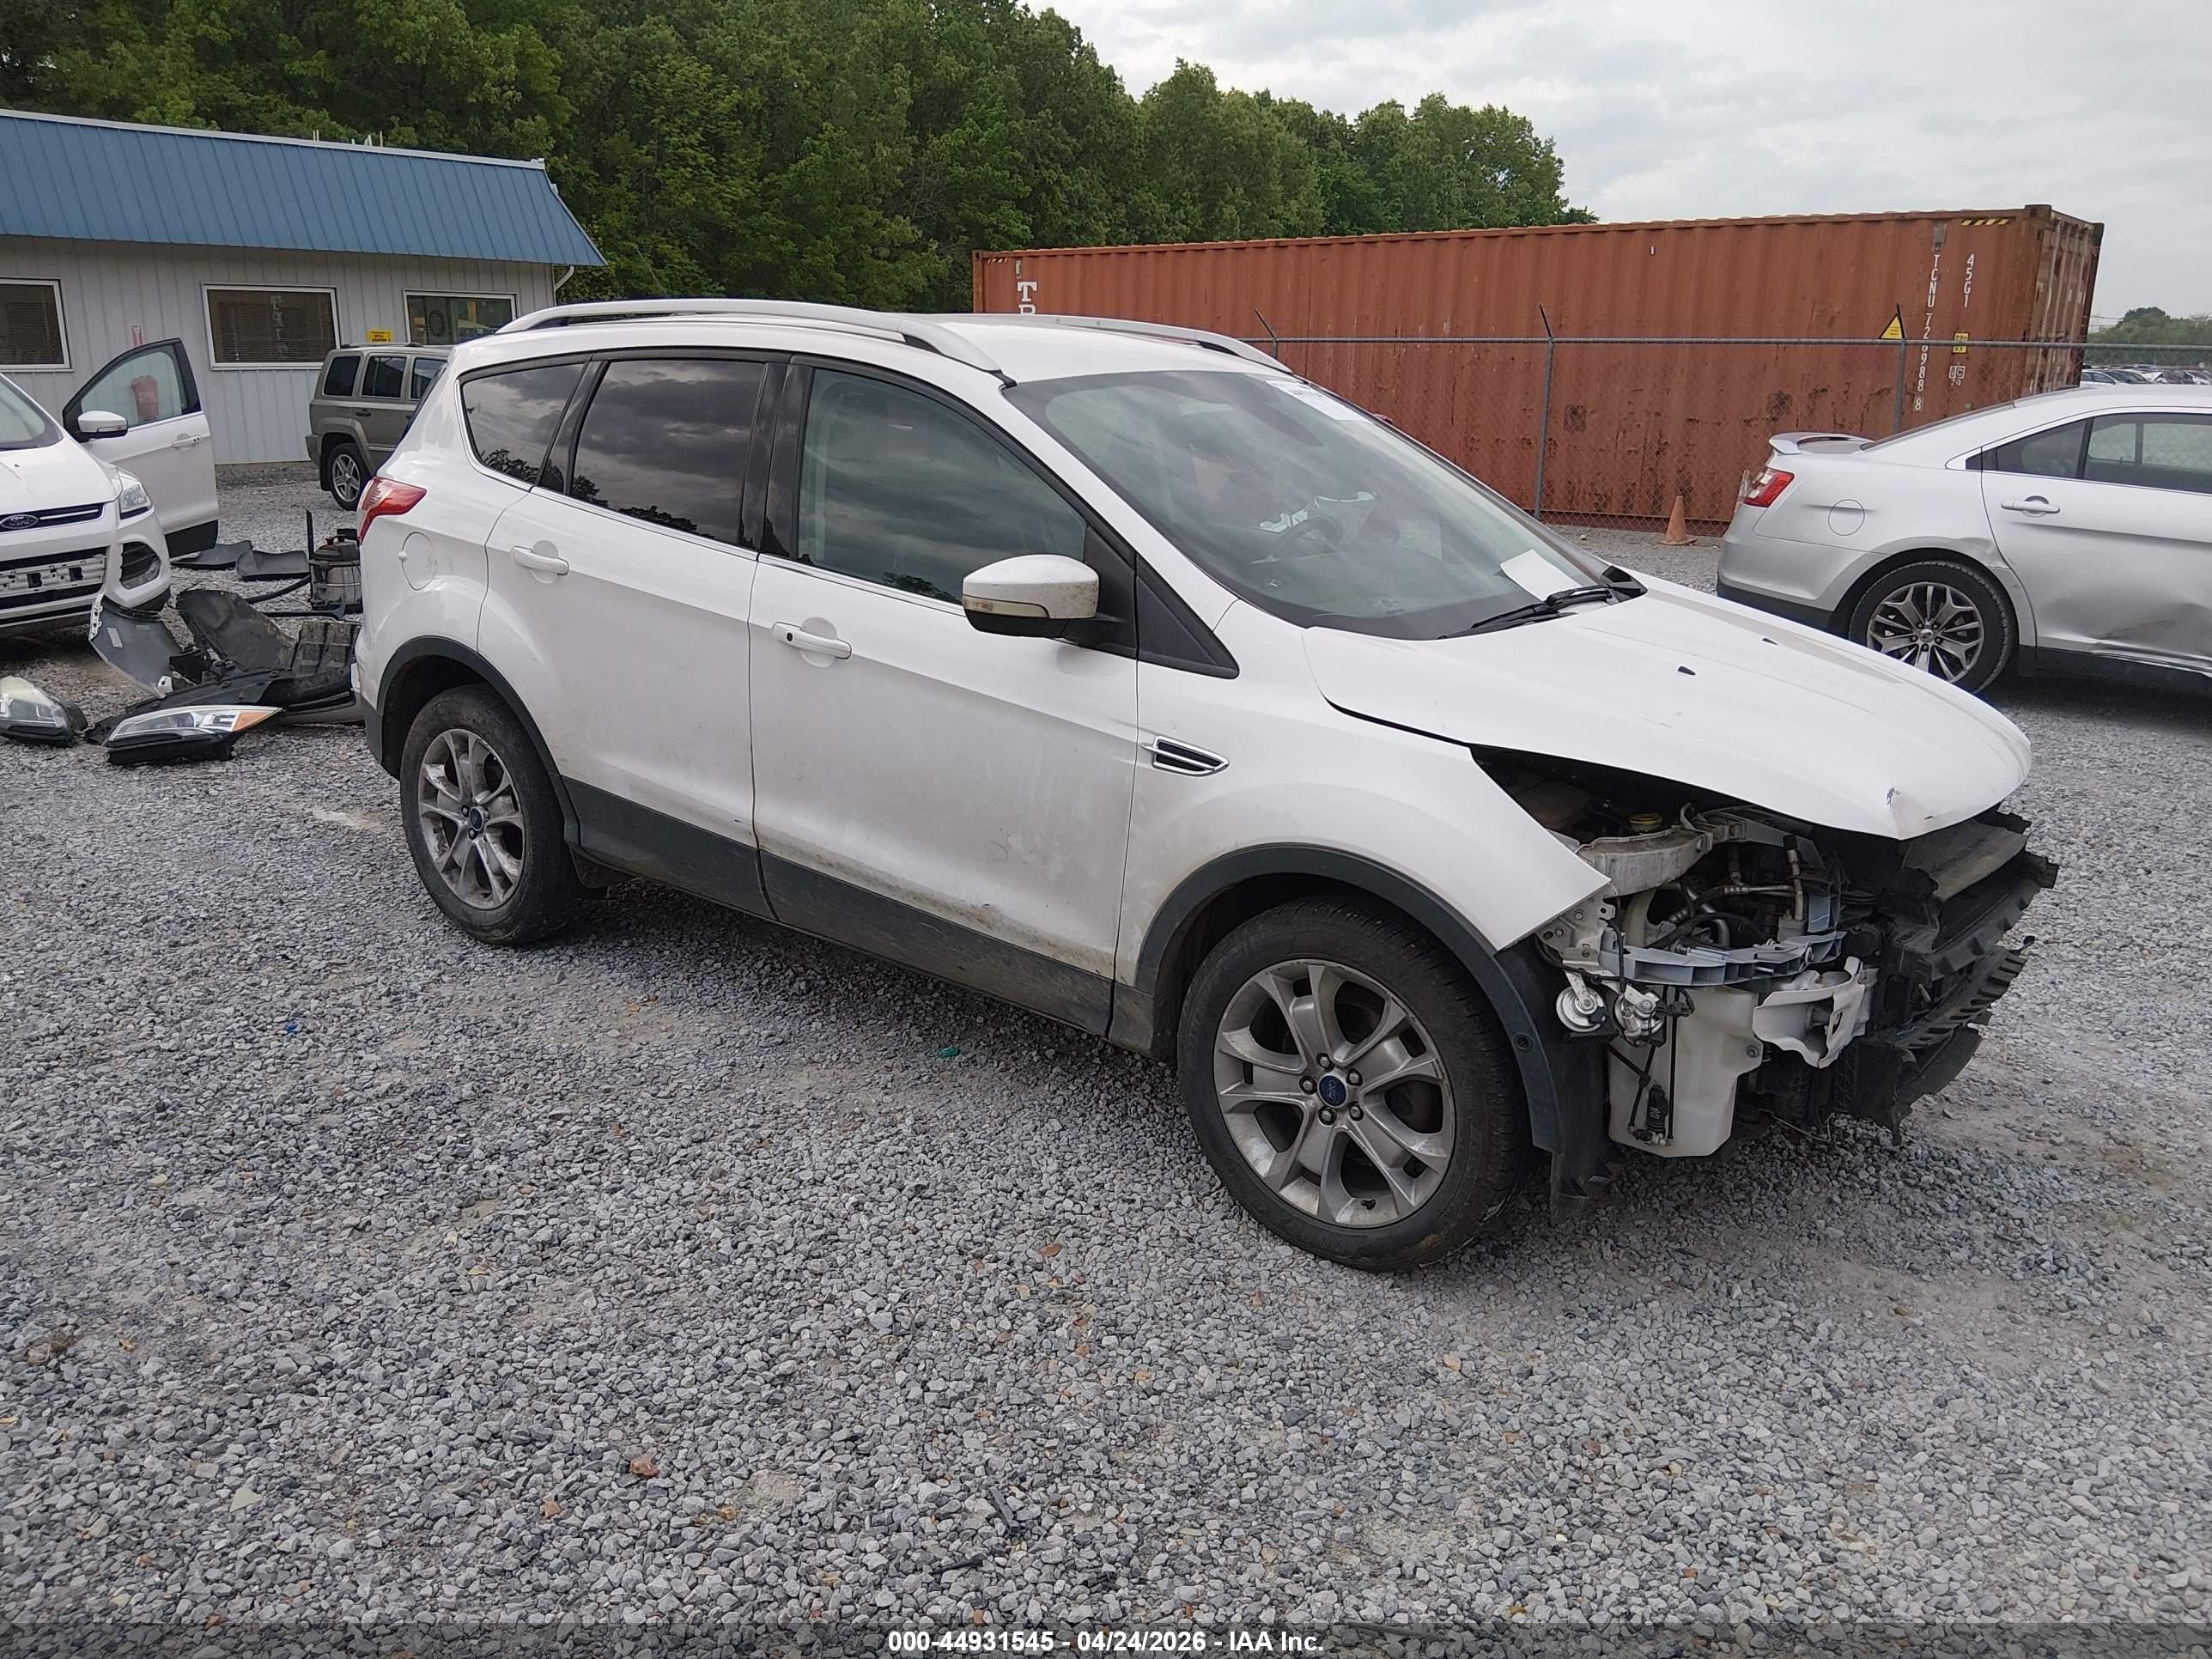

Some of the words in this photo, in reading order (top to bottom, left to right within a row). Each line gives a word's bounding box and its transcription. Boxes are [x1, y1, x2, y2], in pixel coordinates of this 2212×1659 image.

[1927, 254, 1941, 308] TCNU
[1963, 253, 1975, 308] 45G1
[1914, 397, 1923, 410] 8
